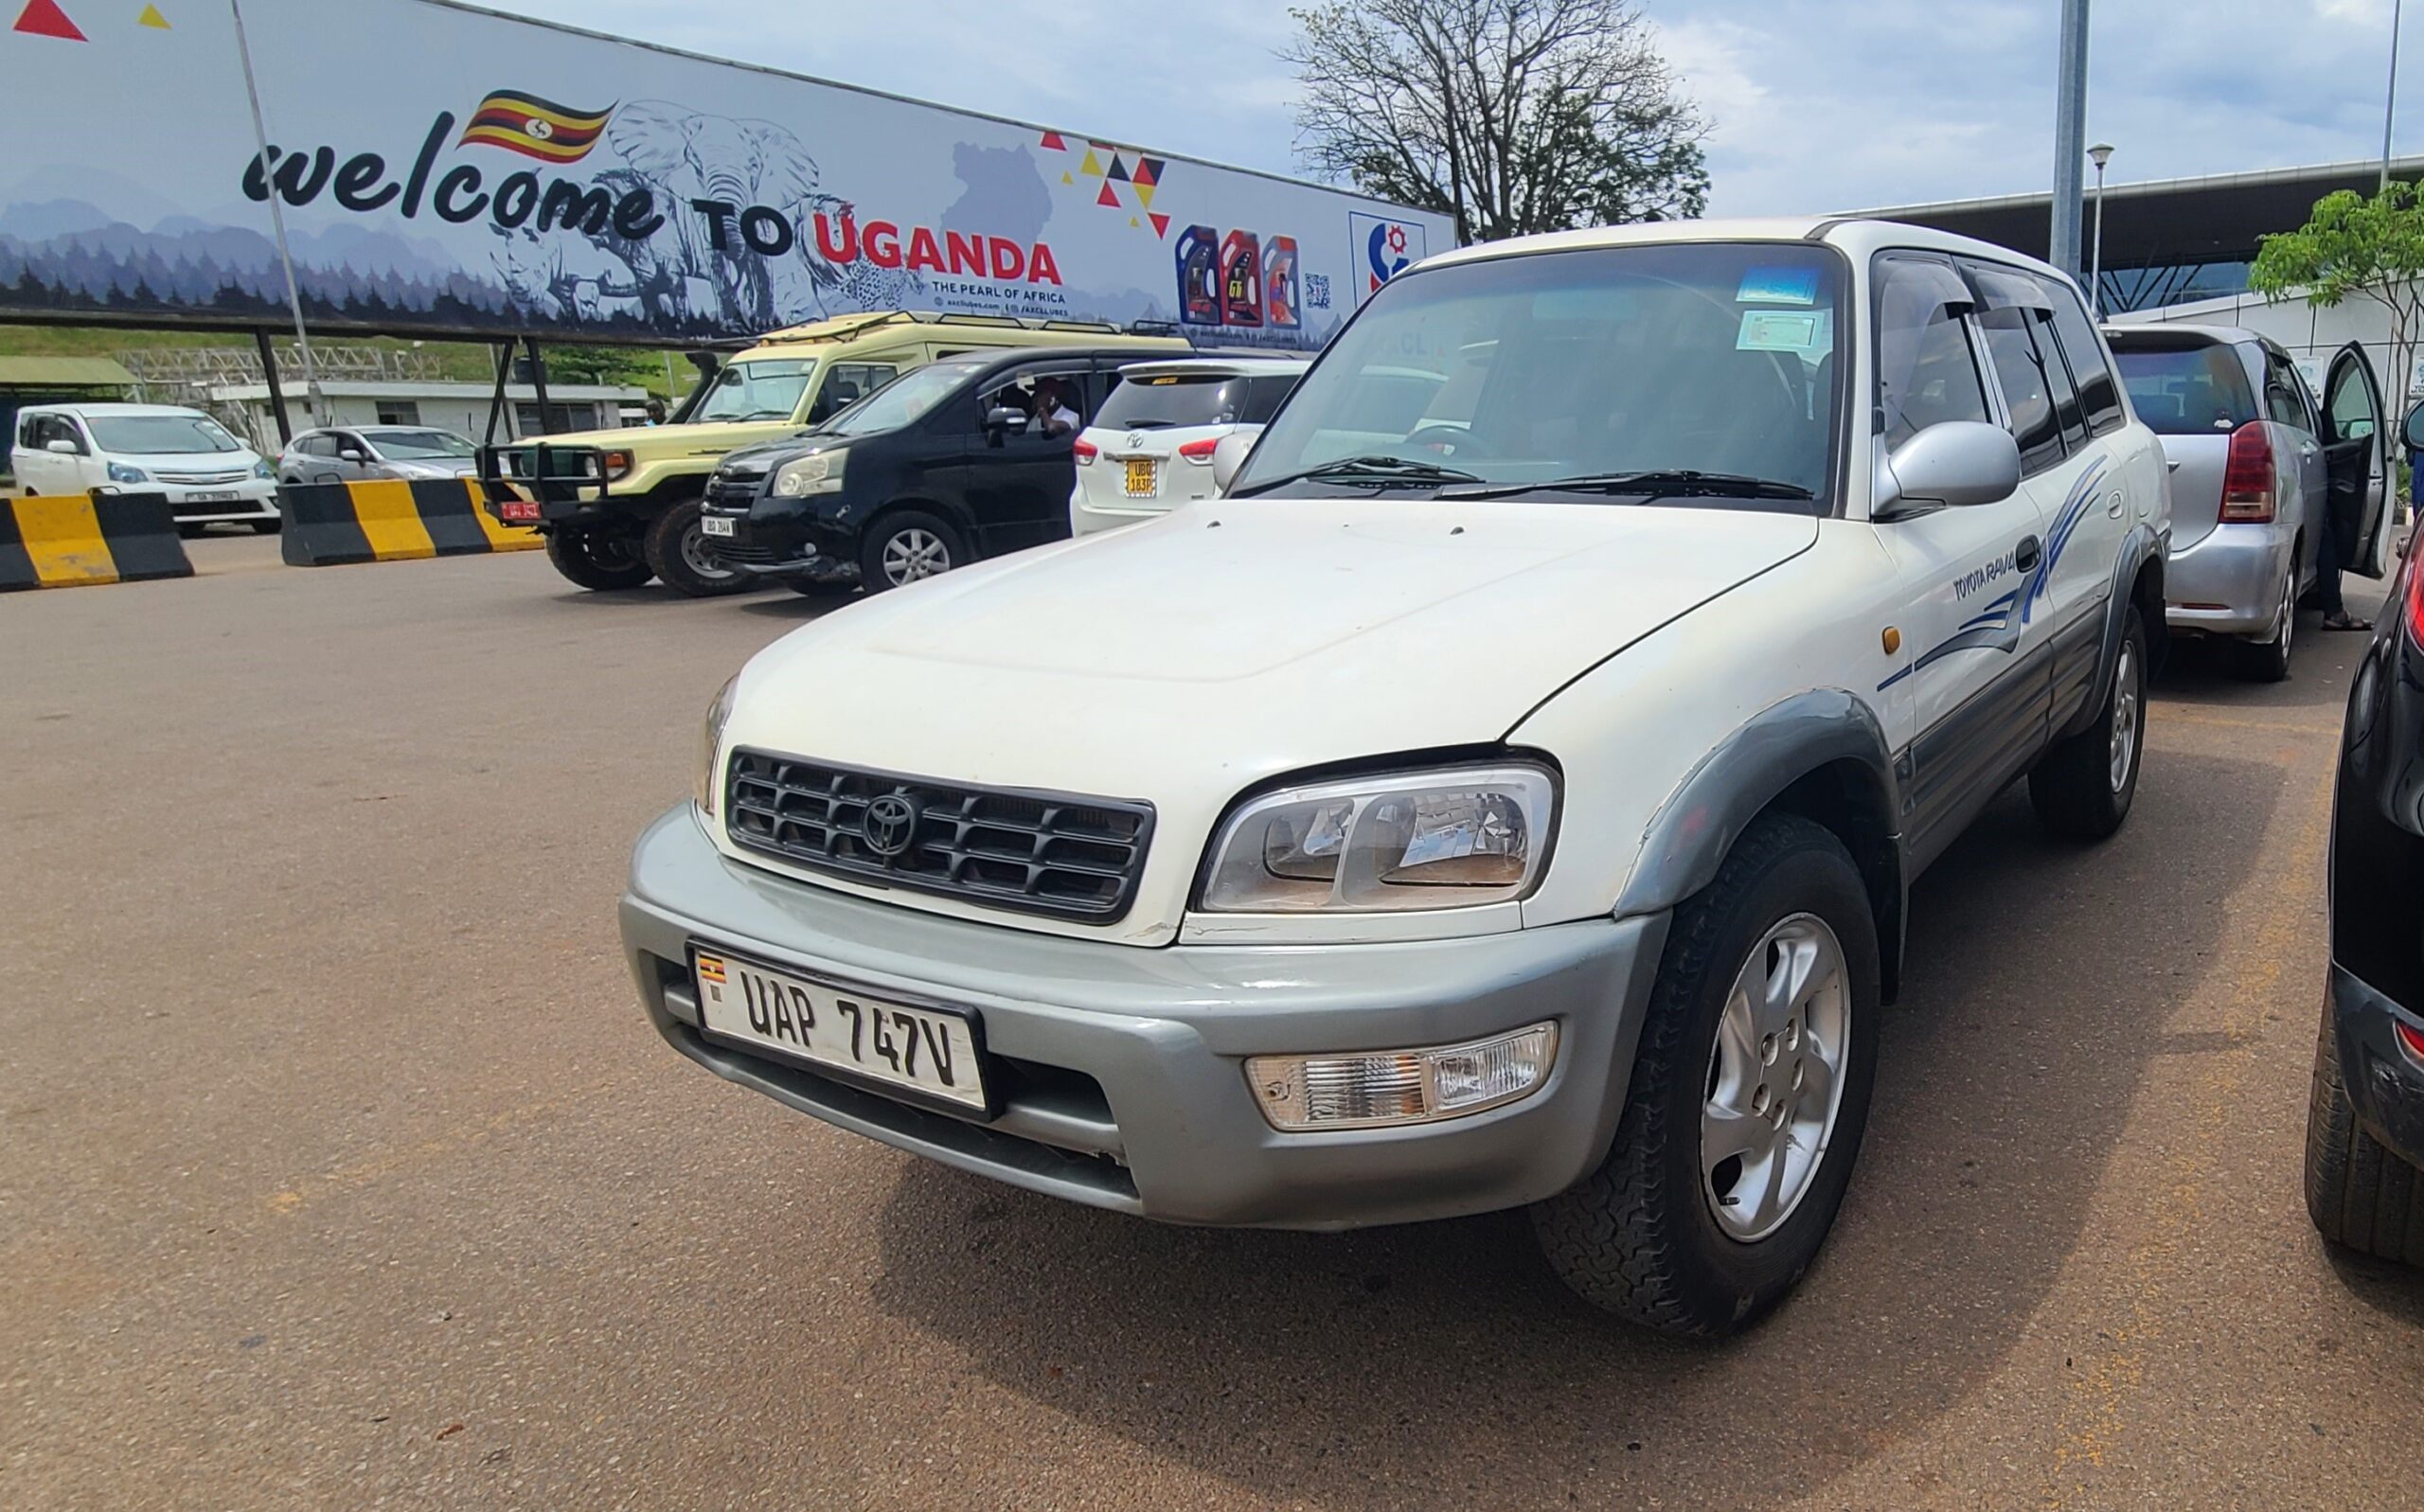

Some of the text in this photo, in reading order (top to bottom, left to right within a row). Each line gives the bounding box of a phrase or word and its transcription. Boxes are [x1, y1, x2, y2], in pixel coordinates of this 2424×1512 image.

[242, 111, 1062, 285] welcome TO UGANDA
[932, 280, 1065, 304] THE PEARL OF AFRICA
[1130, 478, 1152, 491] 183P
[1953, 550, 2016, 601] TOYOTA RAV4
[740, 970, 954, 1087] UAP 747V
